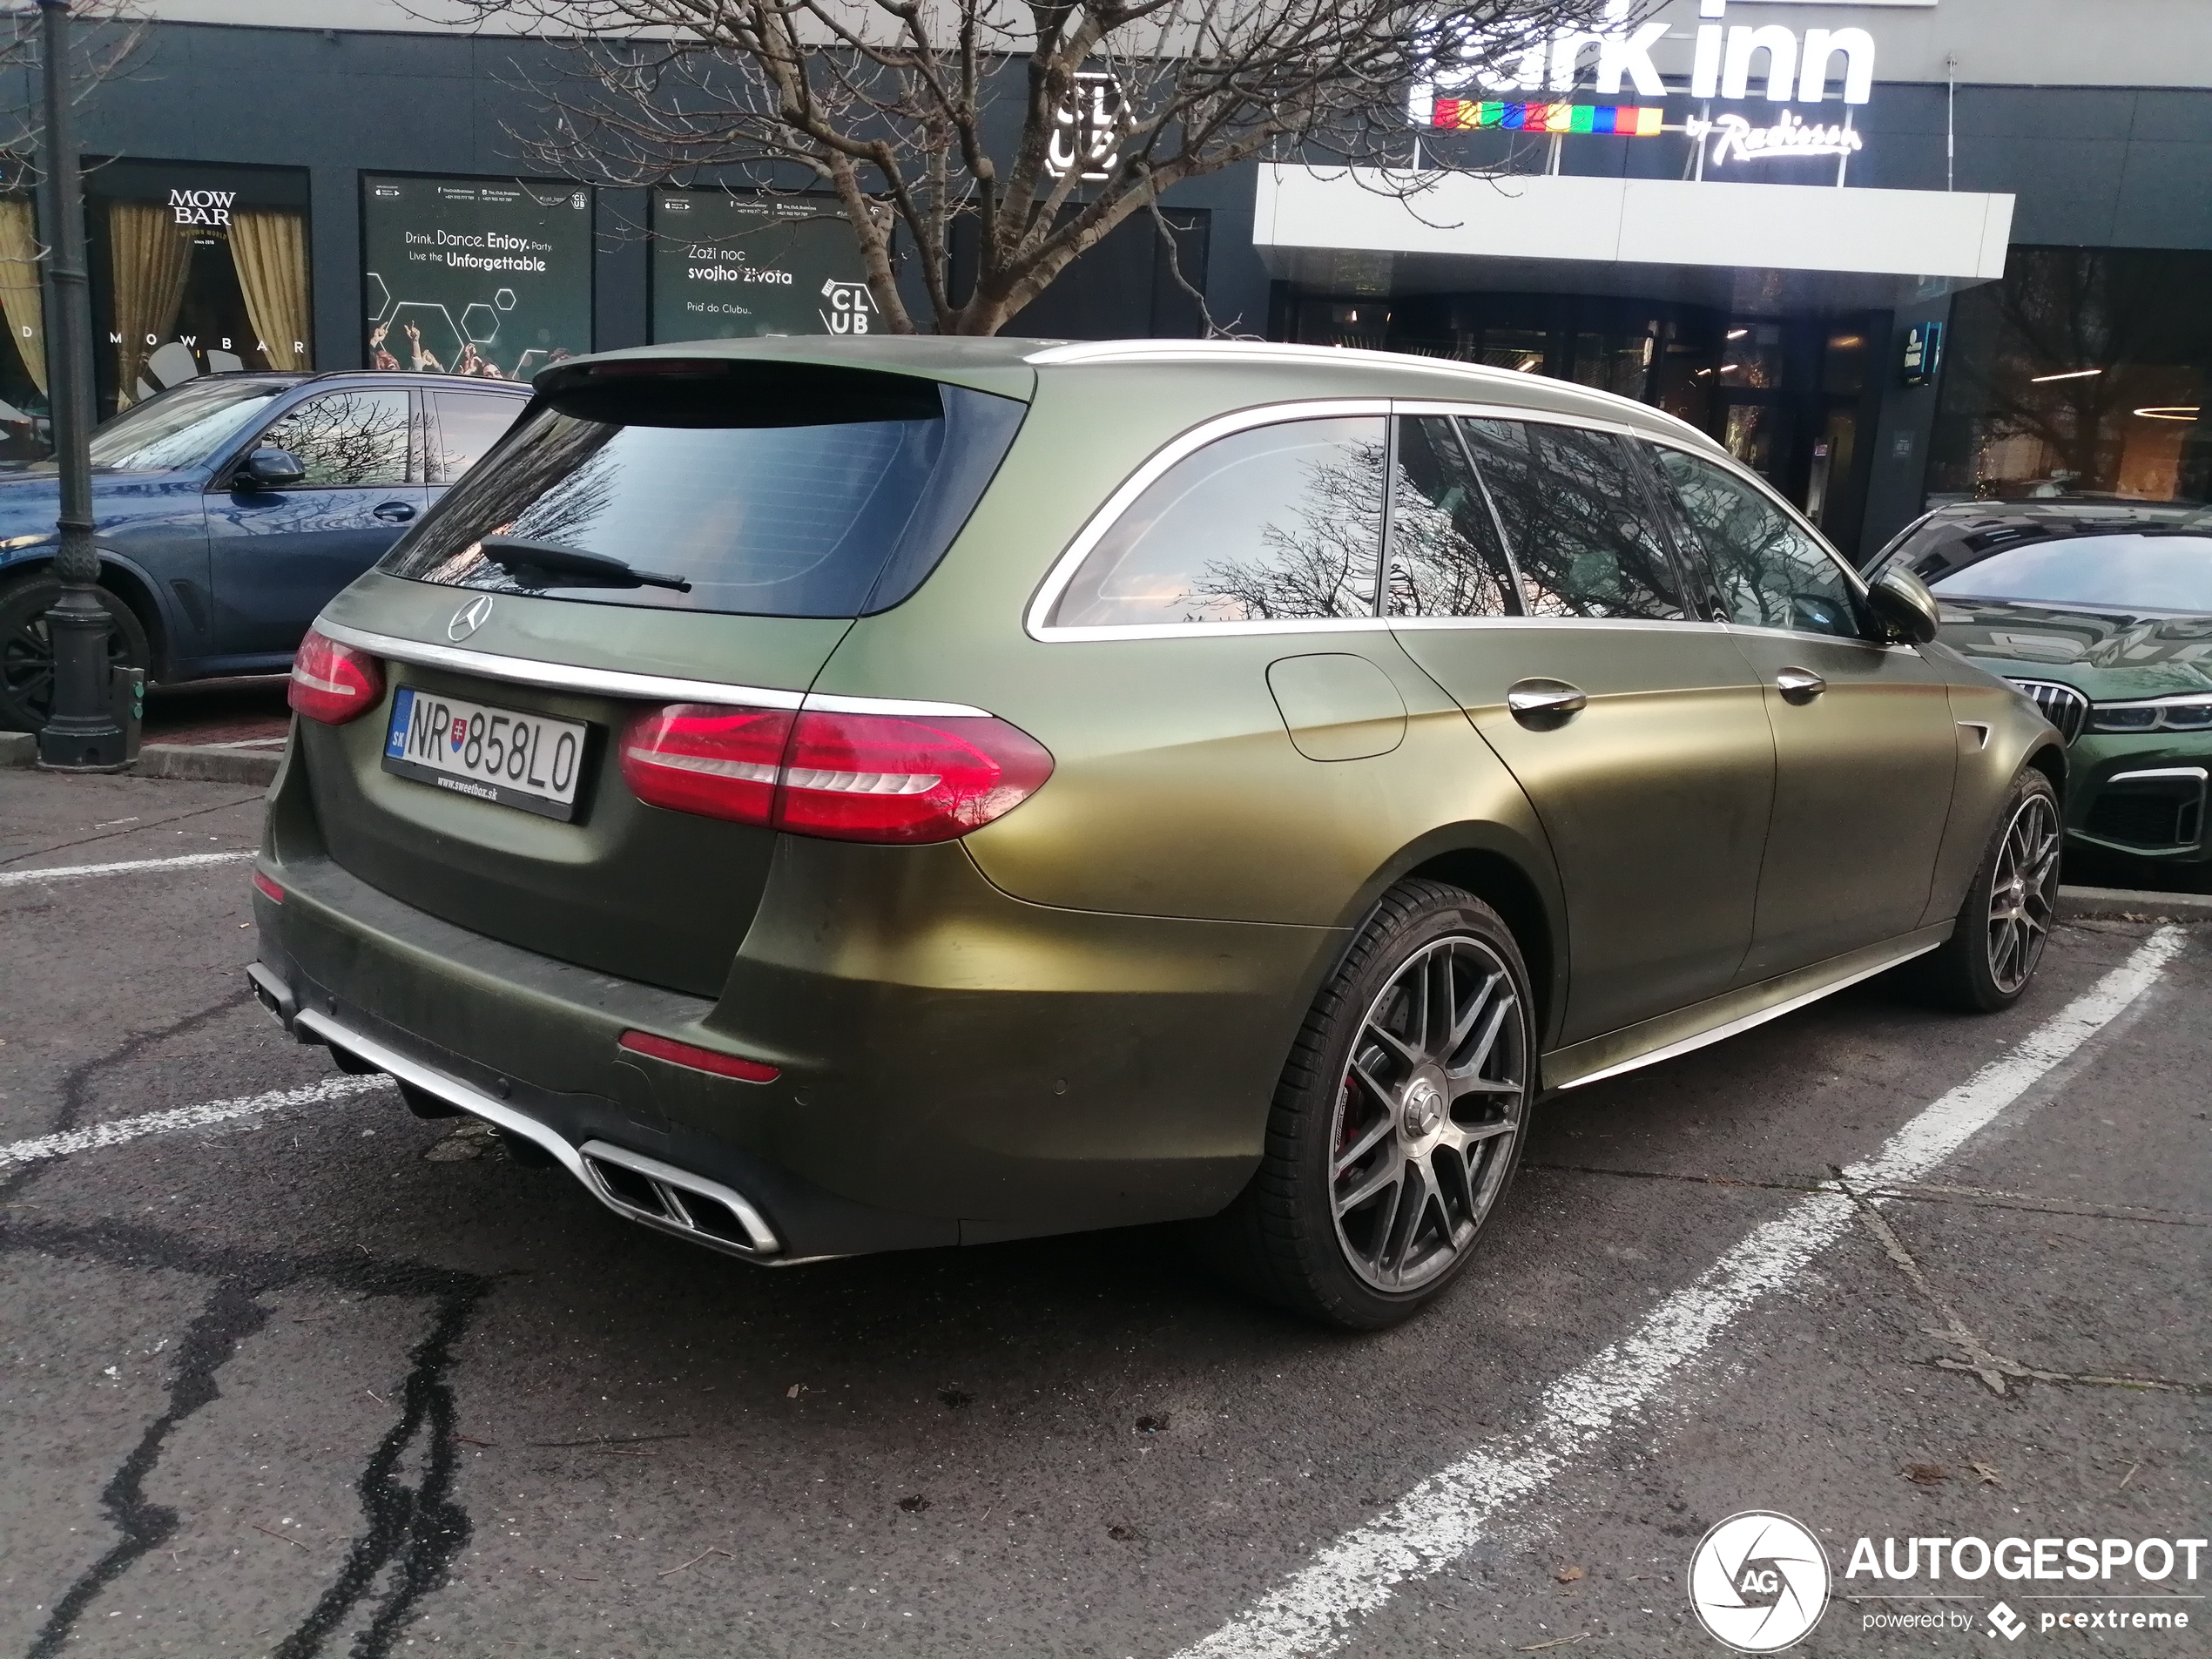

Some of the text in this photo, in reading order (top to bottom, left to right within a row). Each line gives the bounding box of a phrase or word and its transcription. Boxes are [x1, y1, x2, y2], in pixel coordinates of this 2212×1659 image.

[1690, 0, 1876, 105] inn
[1686, 108, 1863, 166] by Radisson
[167, 189, 237, 209] MOW
[173, 206, 233, 226] BAR
[405, 229, 553, 253] Drink. Dance. Enjoy. Party.
[409, 250, 546, 272] Live the Unforgettable
[688, 244, 745, 261] Zaži noc
[688, 264, 792, 285] svojho života
[707, 303, 719, 313] do
[392, 730, 405, 748] SK
[408, 698, 450, 763] NR
[437, 776, 498, 800] www.sweetbox.sk
